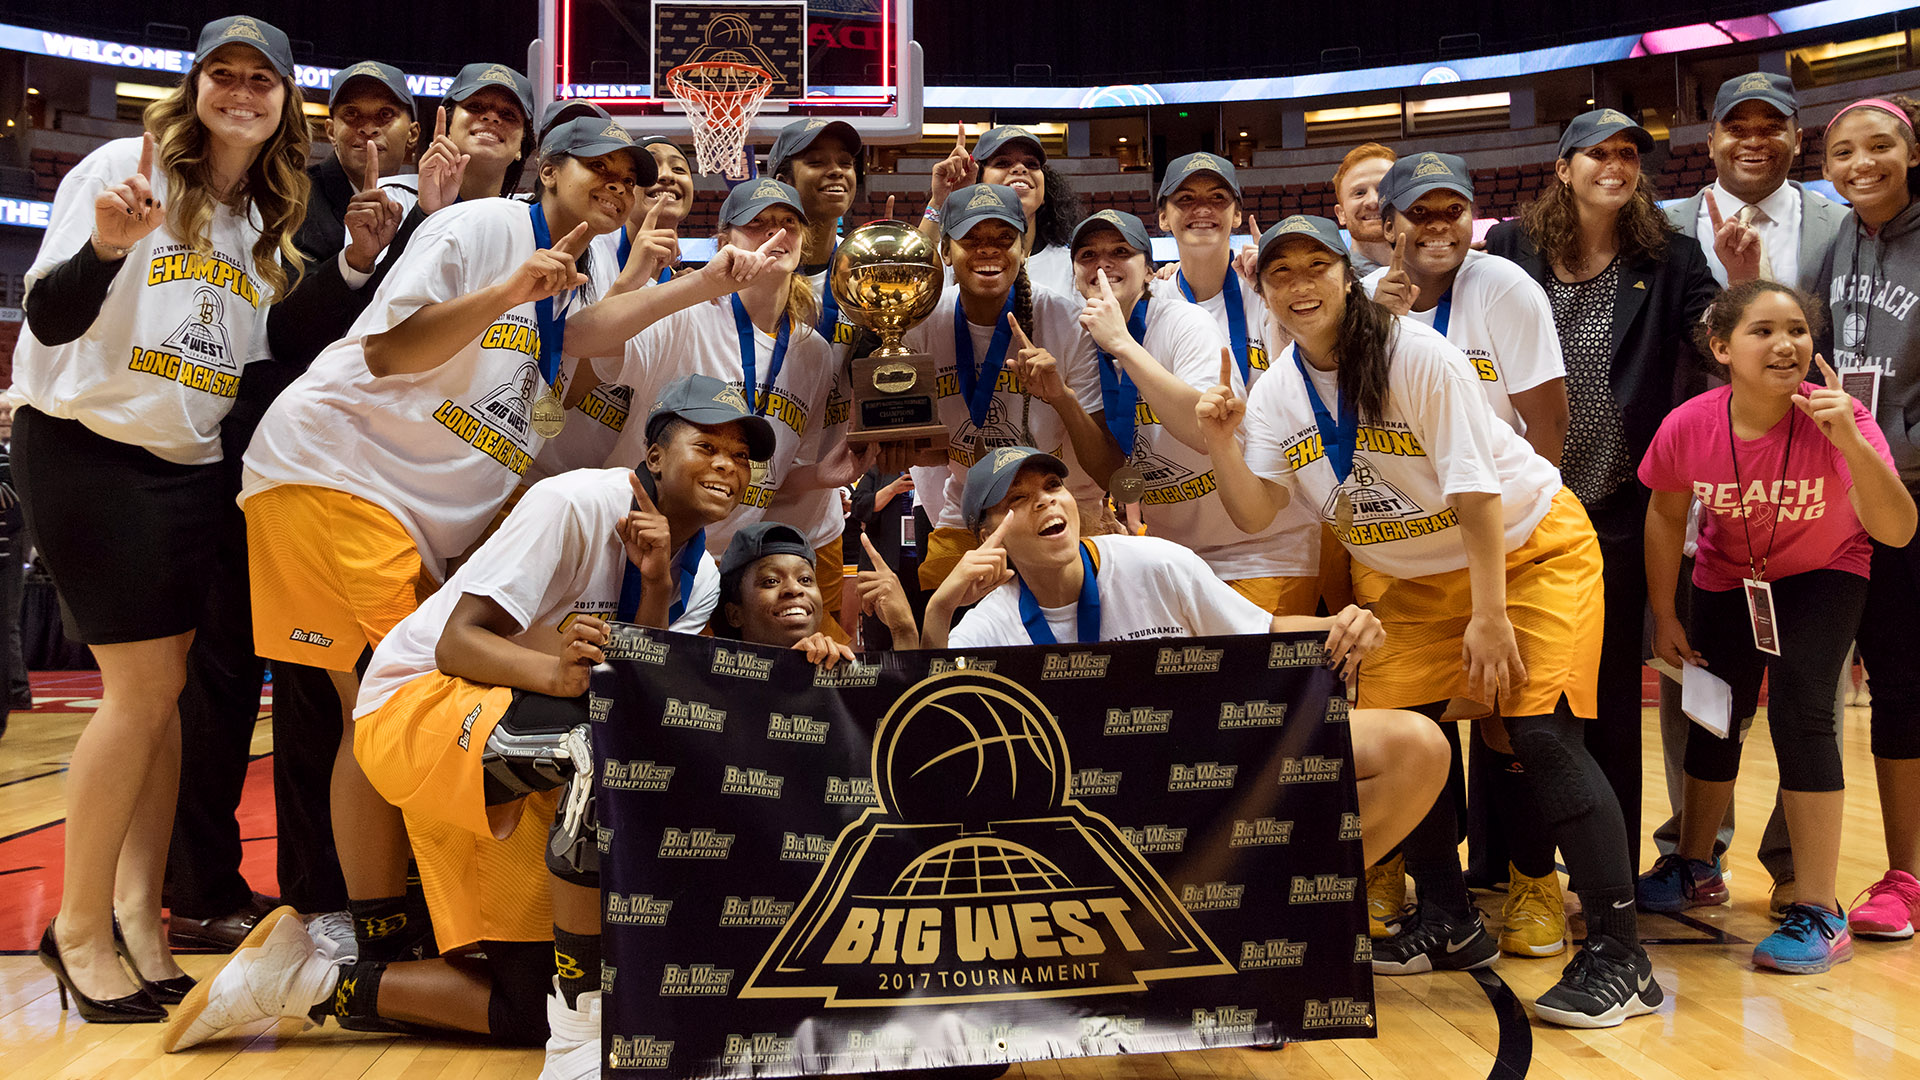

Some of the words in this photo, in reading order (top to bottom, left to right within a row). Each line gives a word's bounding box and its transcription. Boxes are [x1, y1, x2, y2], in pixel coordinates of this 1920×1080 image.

[43, 33, 182, 71] WELCOME
[148, 252, 260, 310] CHAMPION
[190, 338, 224, 359] WEST
[129, 346, 182, 381] LONG
[486, 400, 507, 419] BIG
[509, 410, 528, 436] WEST
[432, 400, 479, 443] LONG
[472, 425, 516, 467] BEACH
[984, 438, 1017, 447] WEST
[1280, 436, 1295, 448] 2017
[1142, 468, 1175, 481] WEST
[1693, 477, 1824, 508] BEACH
[1360, 499, 1402, 512] WEST
[1350, 522, 1407, 545] BEACH
[574, 601, 595, 609] 2017
[1128, 627, 1184, 640] TOURNAMENT
[1296, 643, 1324, 657] WES
[713, 666, 768, 679] CHAMPIONS
[1157, 663, 1217, 672] CHAMPIONS
[1043, 668, 1104, 679] CHAMPIONS
[815, 677, 875, 686] CHAMPIONS
[664, 717, 721, 730] CHAMPIONS
[1221, 717, 1281, 727] CHAMPIONS
[1106, 724, 1167, 734] CHAMPIONS
[769, 731, 824, 742] CHAMPIONS
[1280, 773, 1337, 783] CHAMPIONS
[603, 779, 666, 789] CHAMPIONS
[1170, 780, 1232, 789] CHAMPIONS
[724, 785, 779, 797] CHAMPIONS
[1071, 786, 1116, 795] AMPIONS
[827, 795, 877, 803] CHAMPION
[1232, 835, 1288, 845] CHAMPIONS
[661, 849, 727, 857] CHAMPIONS
[1291, 892, 1352, 902] CHAMPIONS
[608, 913, 665, 924] CHAMPIONS
[722, 917, 786, 925] CHAMPIONS
[822, 906, 942, 965] BIG
[954, 897, 1144, 961] WEST
[1242, 957, 1301, 968] CHAMPIONS
[878, 973, 931, 990] 2017
[937, 961, 1100, 988] TOURNAMENT
[662, 985, 727, 993] CHAMPIONS
[1305, 1018, 1366, 1026] CHAMPIONS
[1194, 1025, 1253, 1034] CHAMPIONS
